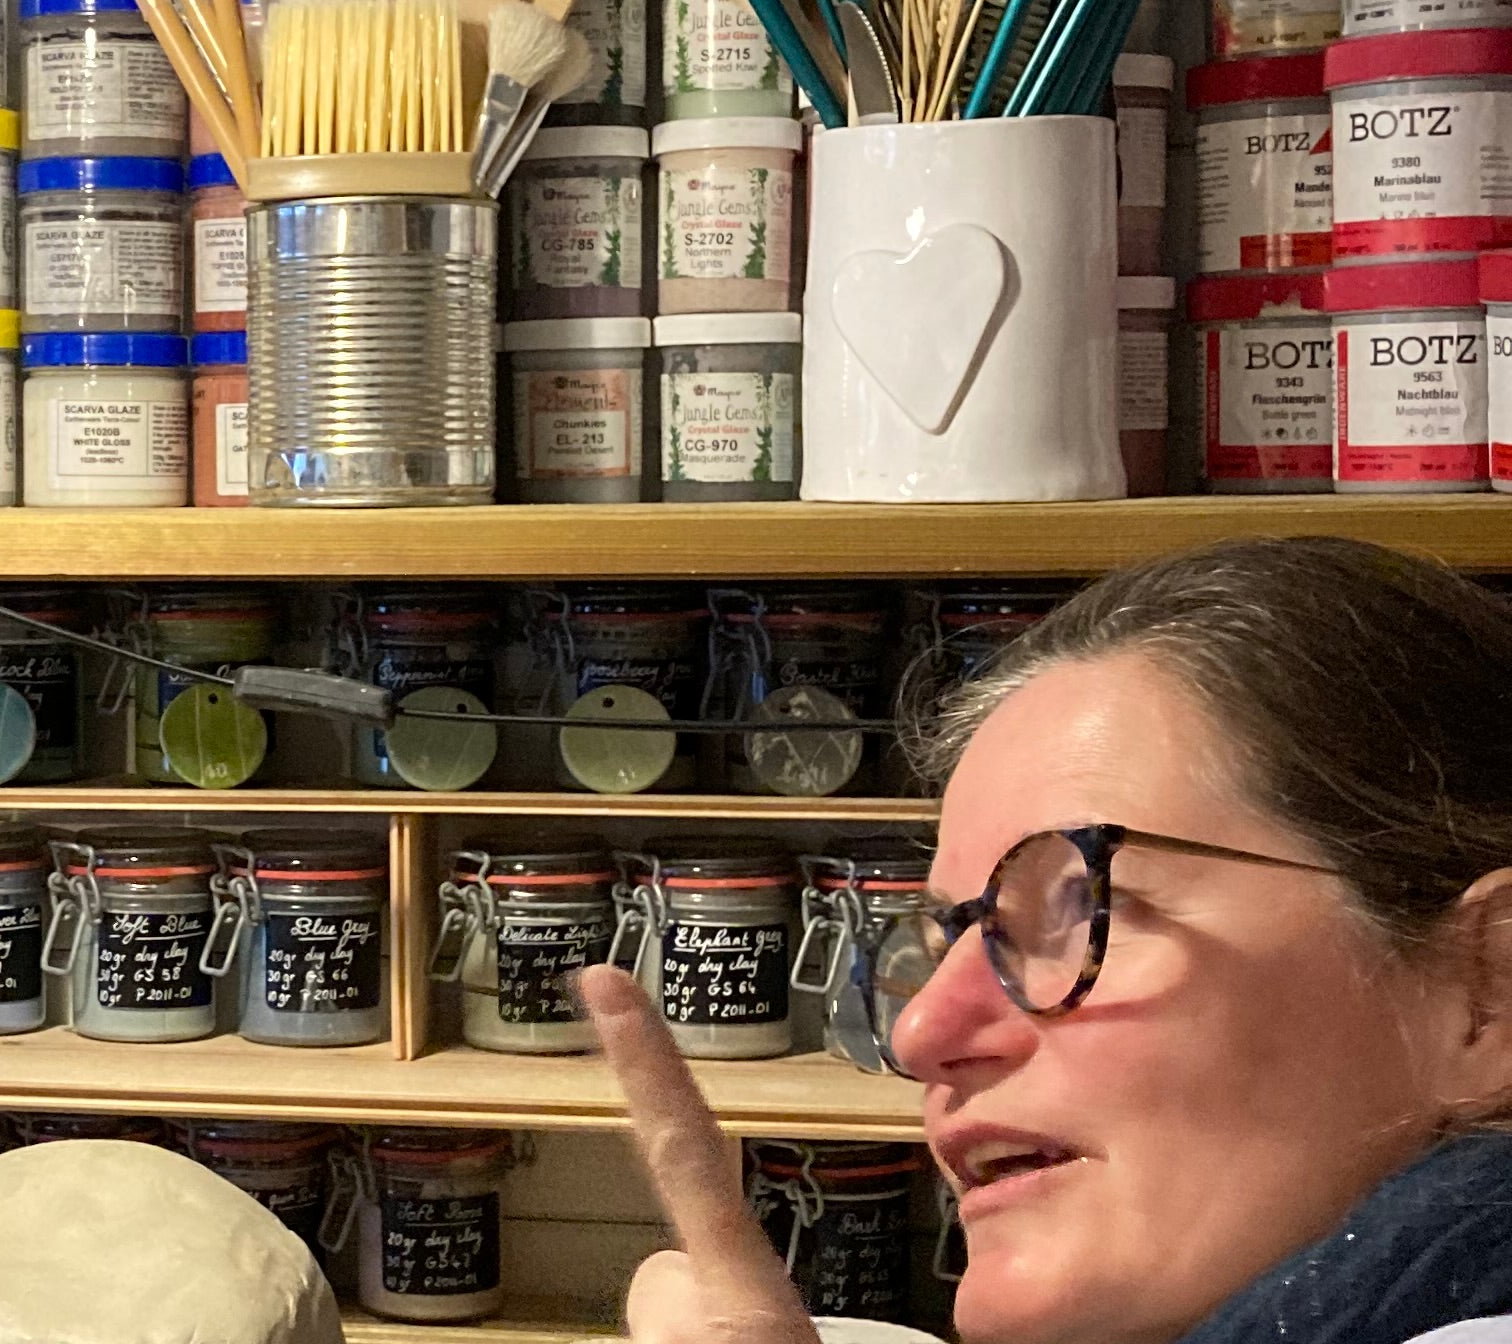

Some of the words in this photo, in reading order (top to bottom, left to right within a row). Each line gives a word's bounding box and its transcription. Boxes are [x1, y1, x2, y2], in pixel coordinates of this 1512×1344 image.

[1349, 106, 1453, 143] BOTZ
[1245, 131, 1311, 155] BOTZ
[1391, 156, 1421, 169] 9380
[1374, 173, 1442, 188] Marinablau
[684, 232, 734, 246] S-2702
[1245, 340, 1333, 371] BOT
[1369, 334, 1478, 367] BOTZ
[1413, 371, 1443, 383] 9563
[1397, 388, 1459, 401] Nachtblau
[64, 405, 105, 415] SCARVA
[108, 405, 142, 415] GLAZE
[83, 427, 121, 437] E1020B
[73, 438, 100, 447] WHITE
[101, 438, 131, 447] GLOSS
[684, 439, 739, 452] CG-970
[112, 913, 150, 945] Soft
[159, 914, 202, 934] Blue
[290, 916, 338, 936] Blue
[674, 926, 750, 956] Elephant
[133, 945, 159, 970] dry
[161, 966, 182, 981] 58
[331, 968, 349, 981] 66
[697, 956, 724, 984] dry
[728, 953, 759, 979] clay
[146, 986, 193, 1001] 2011-01
[708, 1002, 719, 1017] P
[720, 1000, 770, 1018] 2011-01
